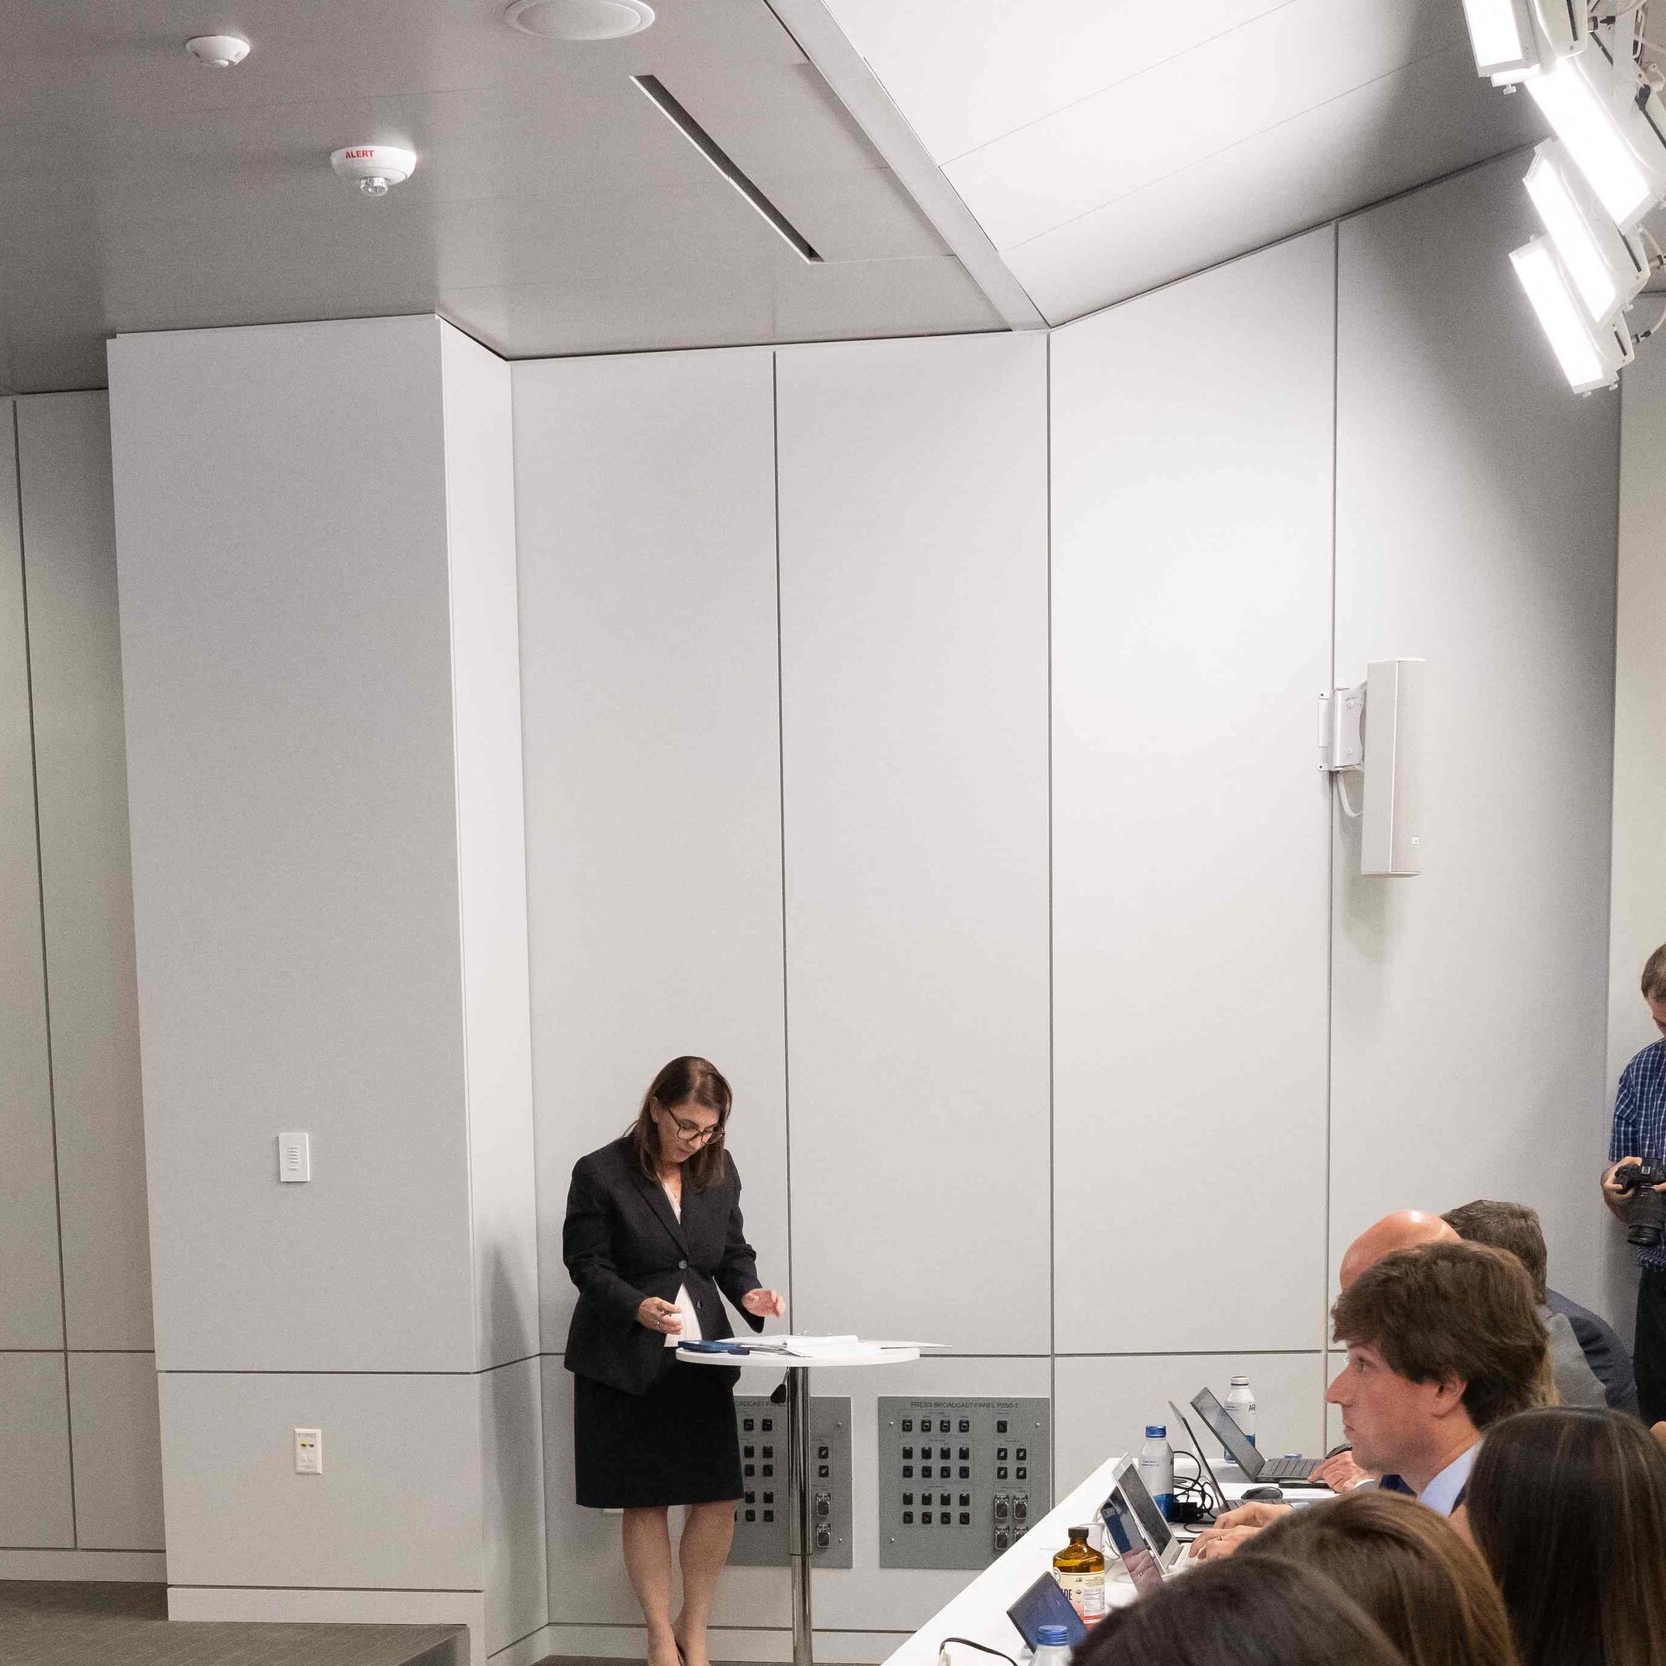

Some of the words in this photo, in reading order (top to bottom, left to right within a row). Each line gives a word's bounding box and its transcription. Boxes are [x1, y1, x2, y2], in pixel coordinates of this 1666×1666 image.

[910, 1401, 932, 1409] PRESS
[934, 1401, 973, 1409] BROADCAST
[974, 1401, 995, 1409] PANEL
